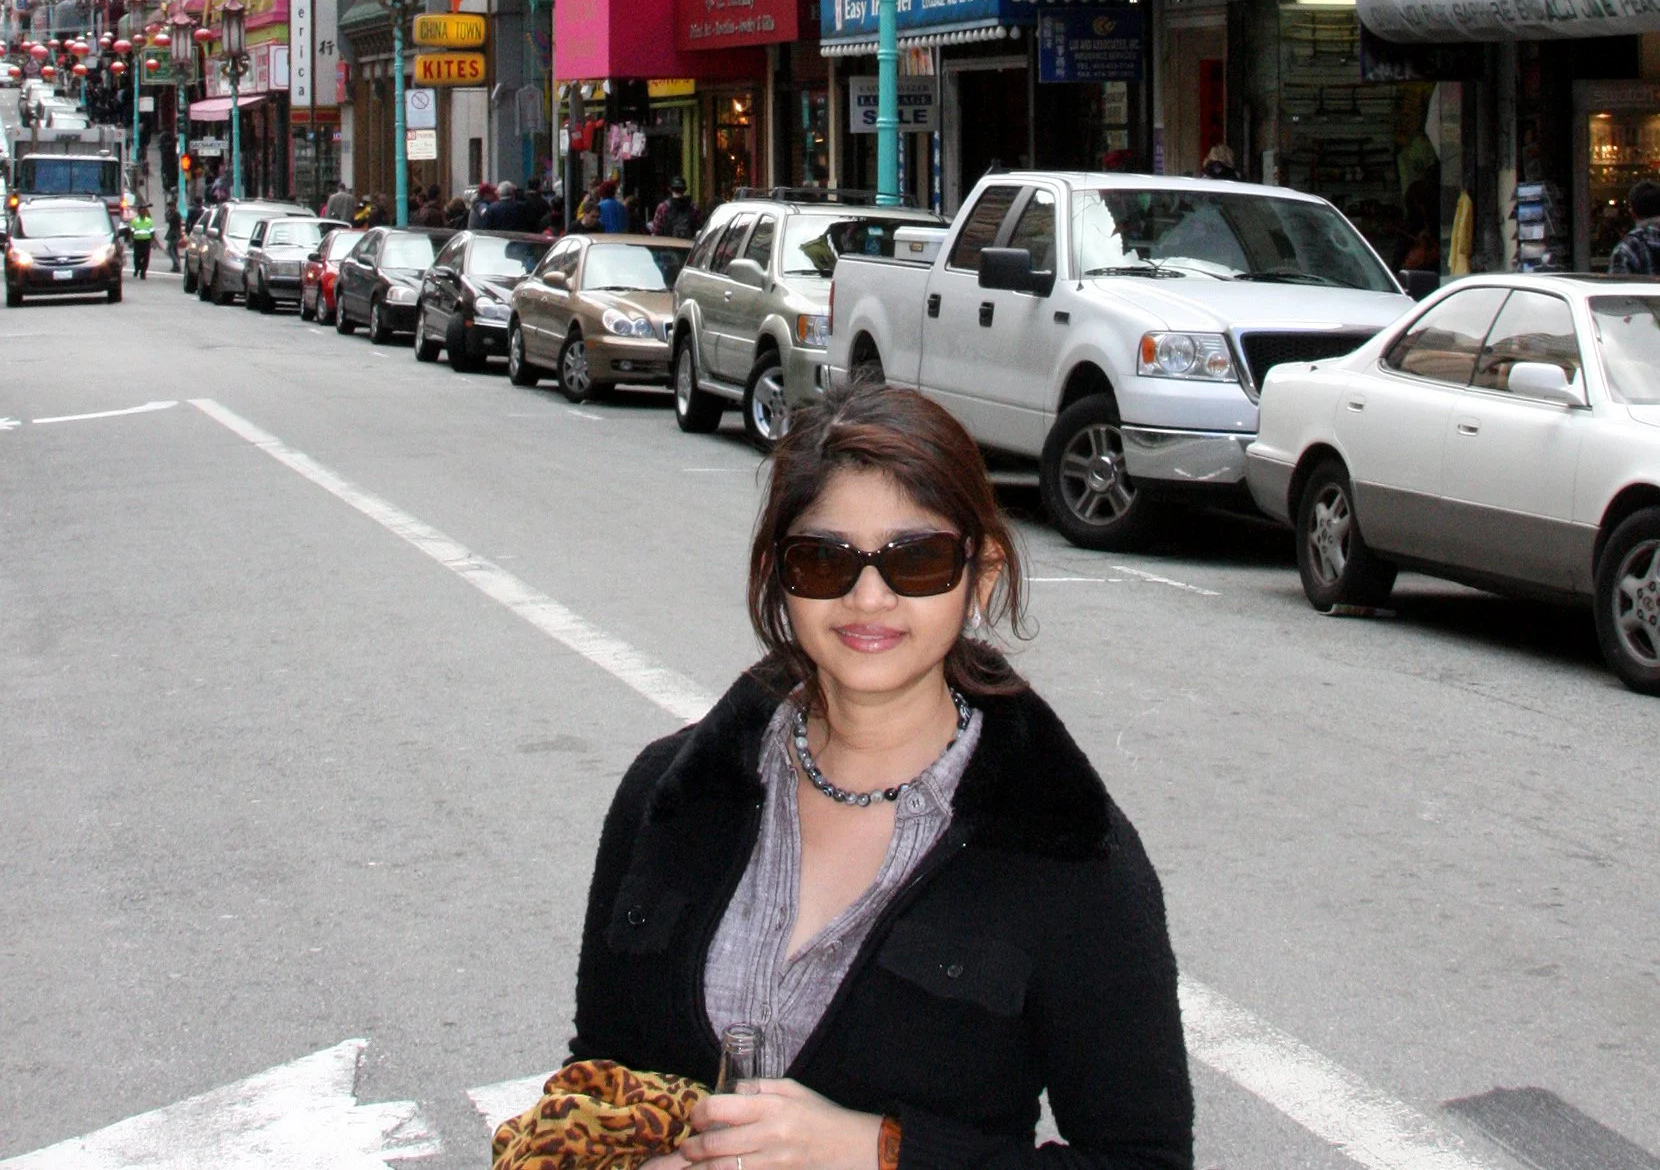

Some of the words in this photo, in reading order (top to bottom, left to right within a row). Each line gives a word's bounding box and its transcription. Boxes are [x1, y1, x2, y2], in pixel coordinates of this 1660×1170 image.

[420, 21, 448, 40] CHINA
[455, 21, 482, 40] TOWN
[423, 59, 480, 79] KITES
[860, 94, 931, 106] LUAGE
[862, 109, 928, 125] SLE
